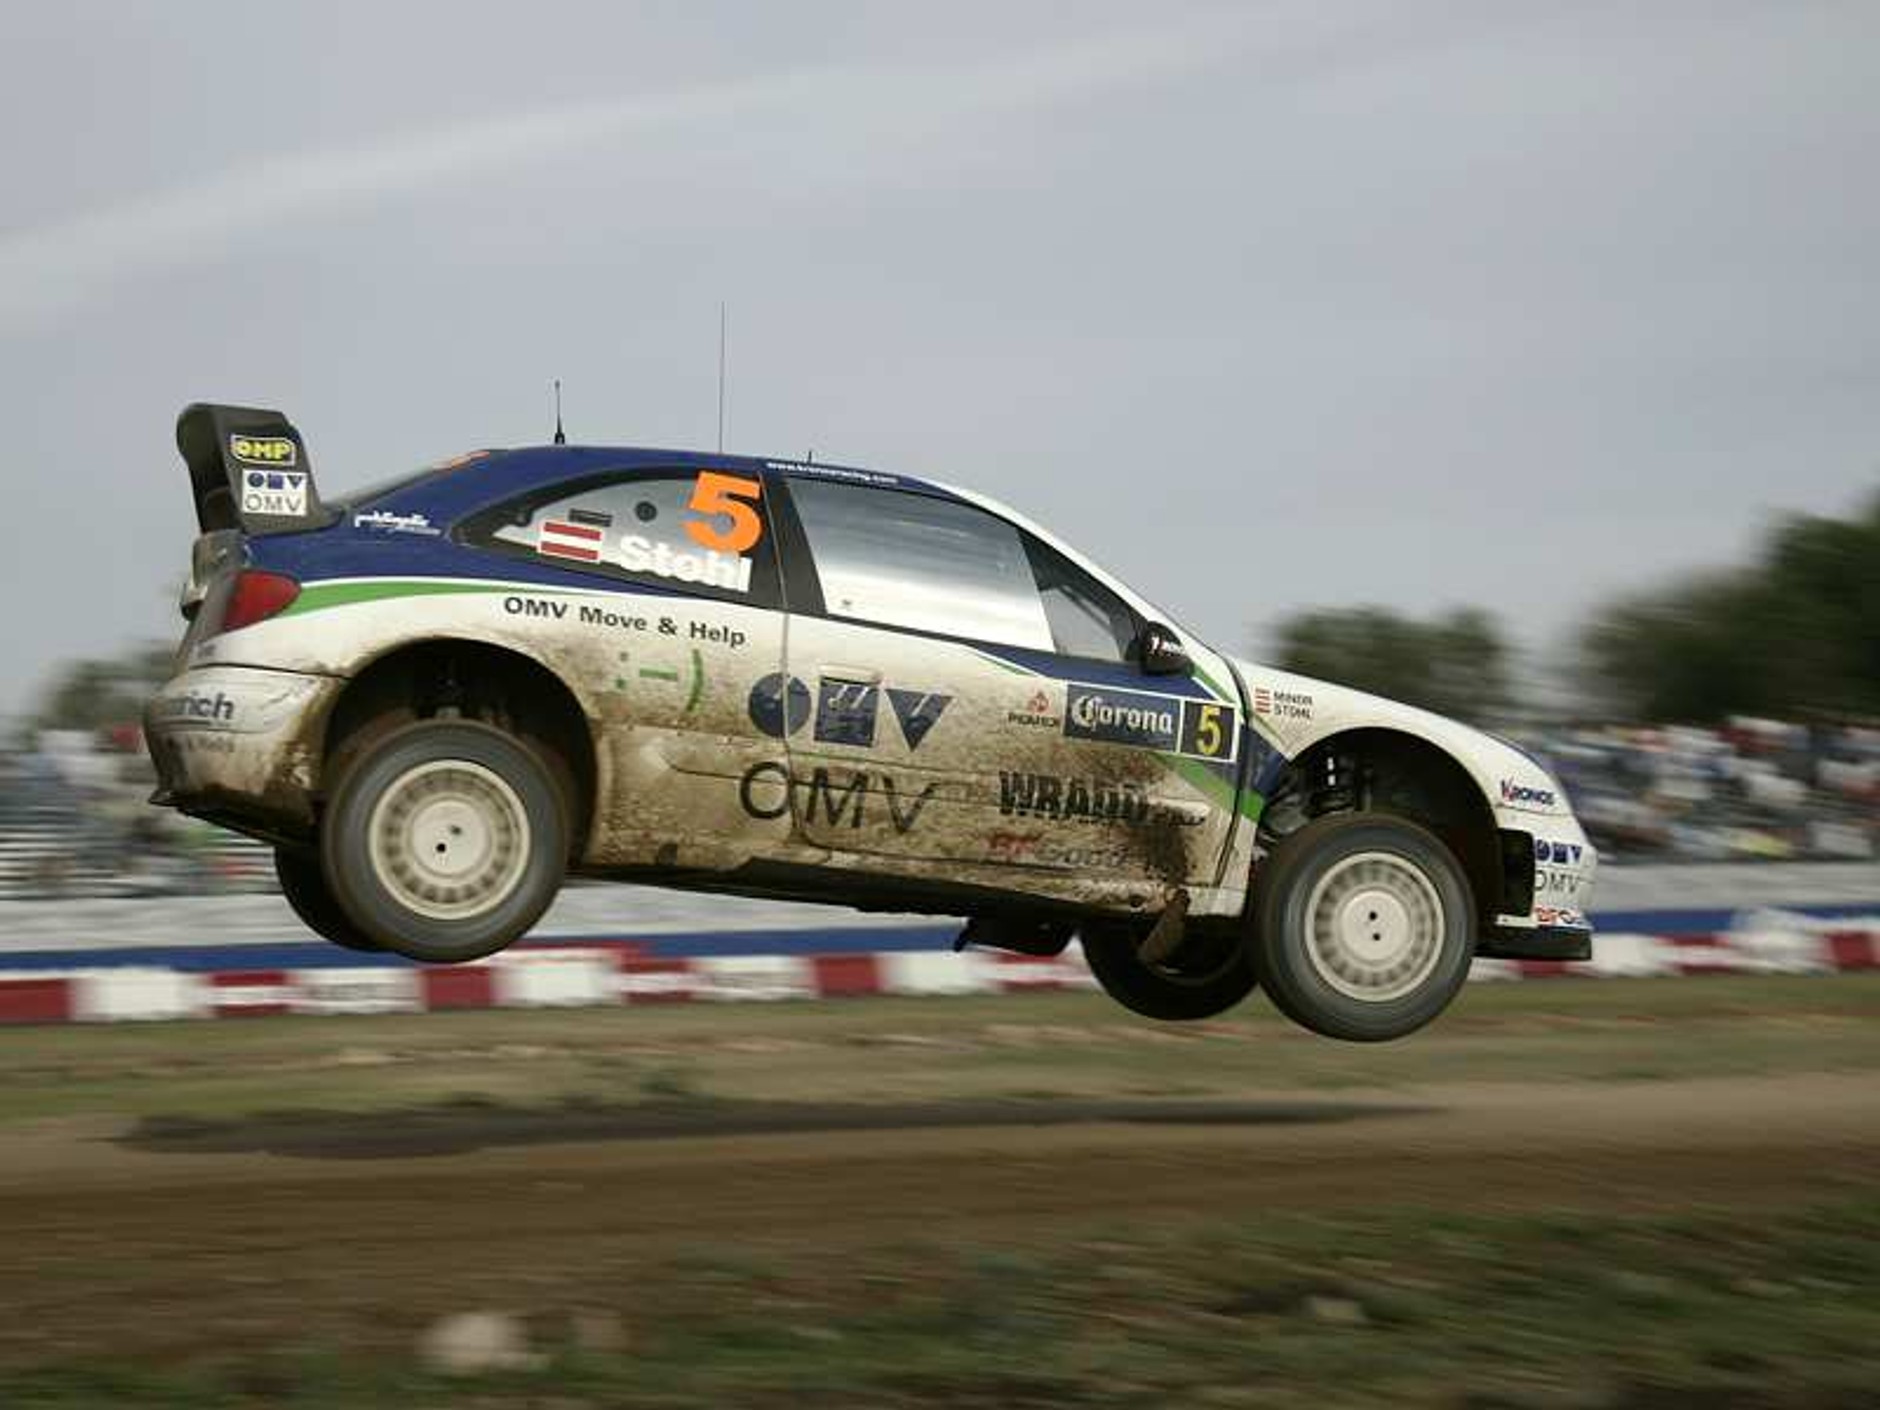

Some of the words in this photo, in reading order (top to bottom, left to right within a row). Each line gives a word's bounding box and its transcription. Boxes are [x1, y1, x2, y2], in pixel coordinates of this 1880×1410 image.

[233, 438, 291, 461] OMP
[245, 494, 303, 513] OMV
[681, 470, 763, 553] 5
[619, 535, 752, 593] Stohl
[504, 597, 568, 620] OMV
[579, 606, 648, 632] Move
[658, 617, 678, 636] &
[689, 621, 746, 648] Help
[1070, 694, 1174, 735] Corona
[1195, 705, 1223, 755] 5
[739, 761, 942, 836] OMV
[1534, 869, 1580, 894] OMV
